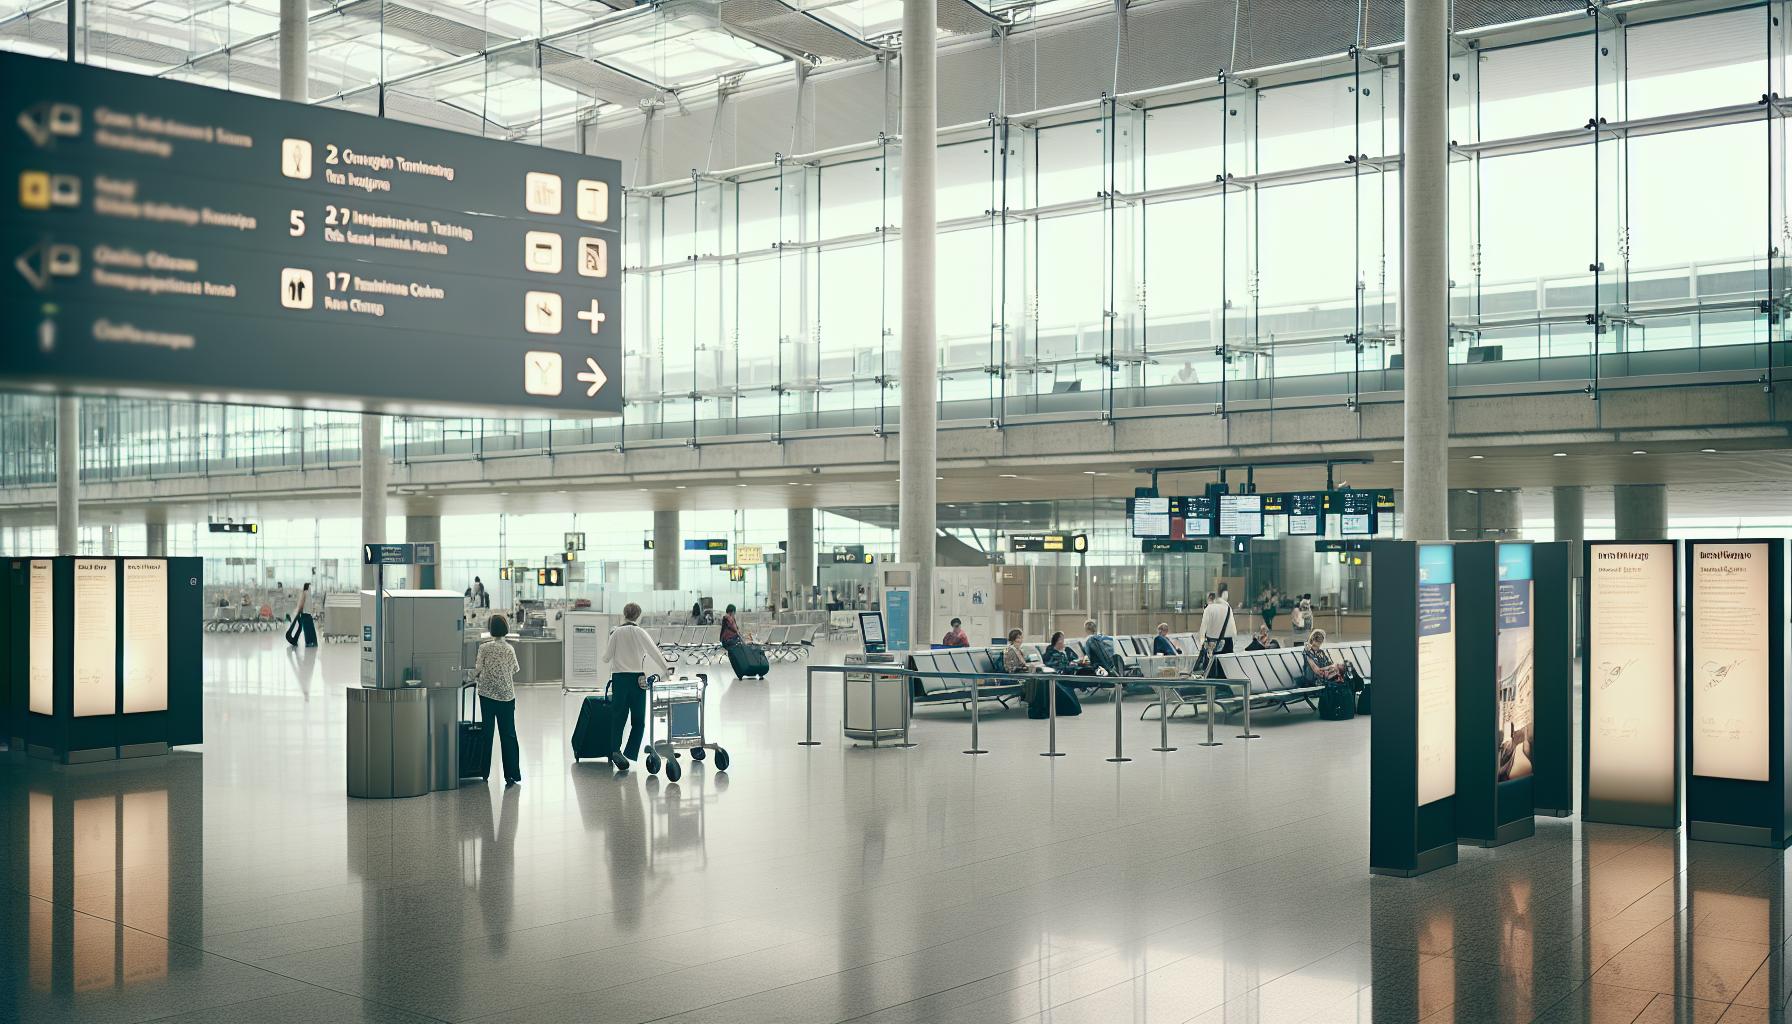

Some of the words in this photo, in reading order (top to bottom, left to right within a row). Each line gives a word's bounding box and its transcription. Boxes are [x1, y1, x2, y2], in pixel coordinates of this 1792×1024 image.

[326, 144, 338, 164] 2
[290, 210, 306, 236] 5
[325, 205, 350, 225] 27
[326, 271, 351, 292] 17
